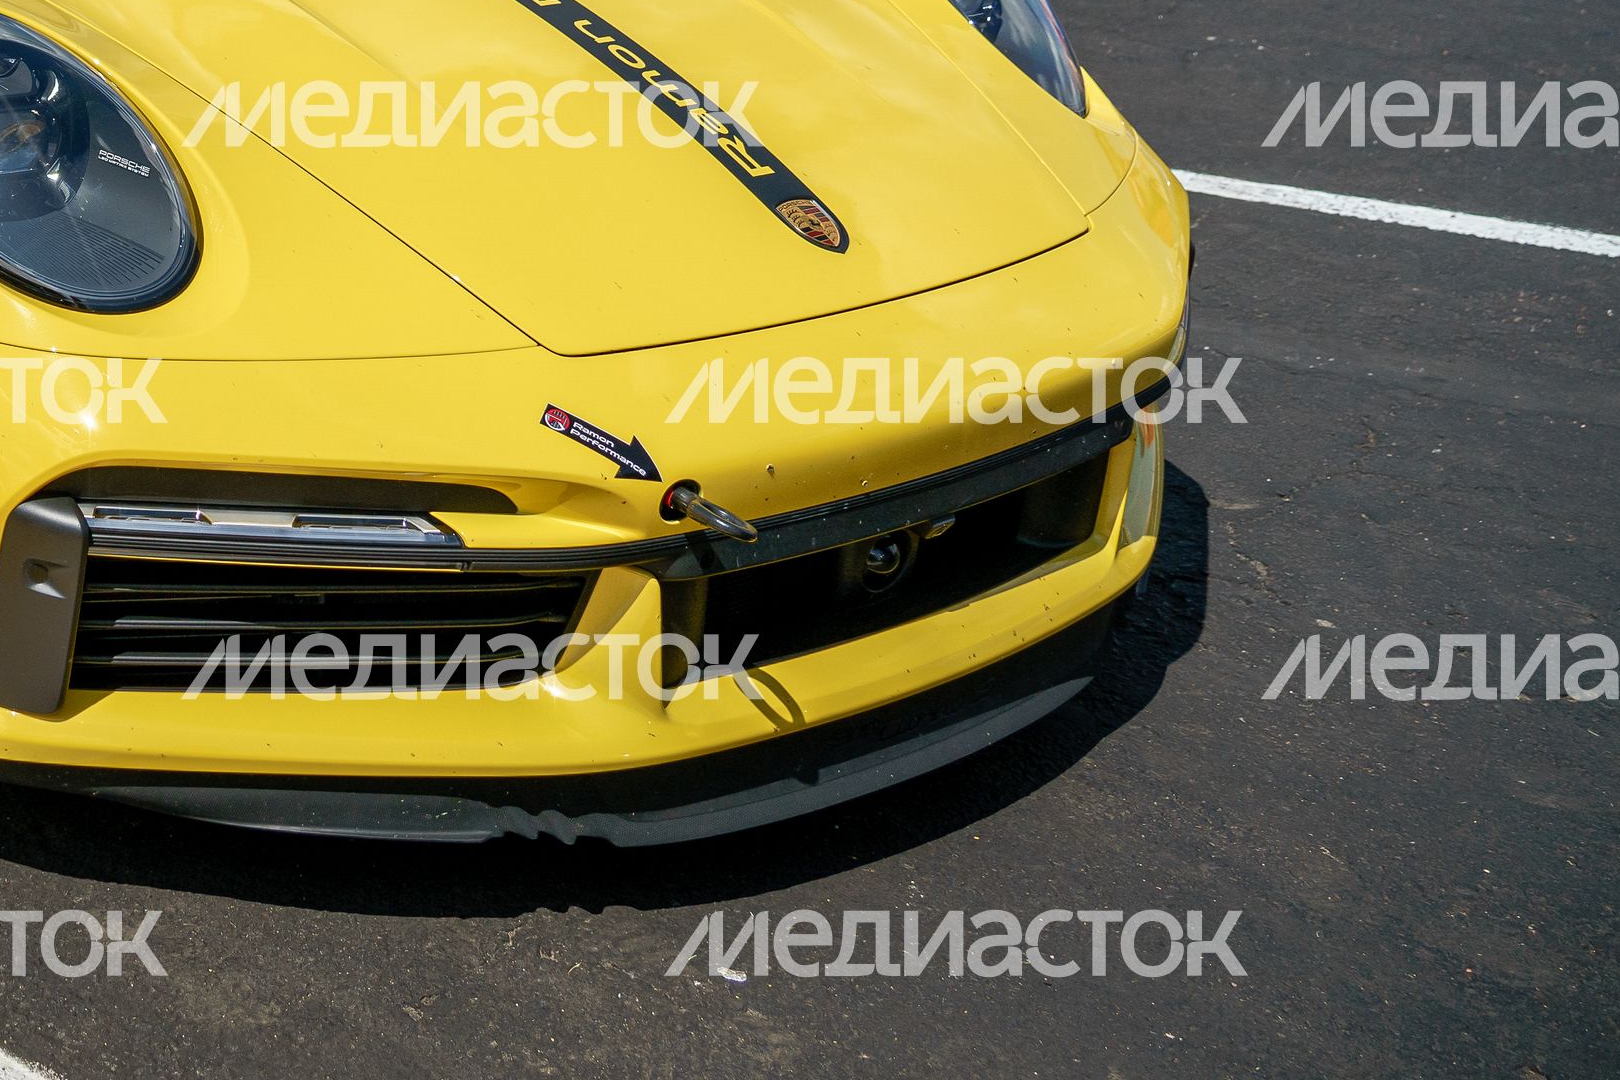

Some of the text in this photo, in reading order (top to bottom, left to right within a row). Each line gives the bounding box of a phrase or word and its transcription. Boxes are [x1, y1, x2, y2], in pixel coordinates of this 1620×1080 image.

[572, 18, 776, 179] Ramon
[99, 149, 151, 173] PORSCHE
[569, 427, 647, 477] Performance
[572, 421, 615, 448] Ramon
